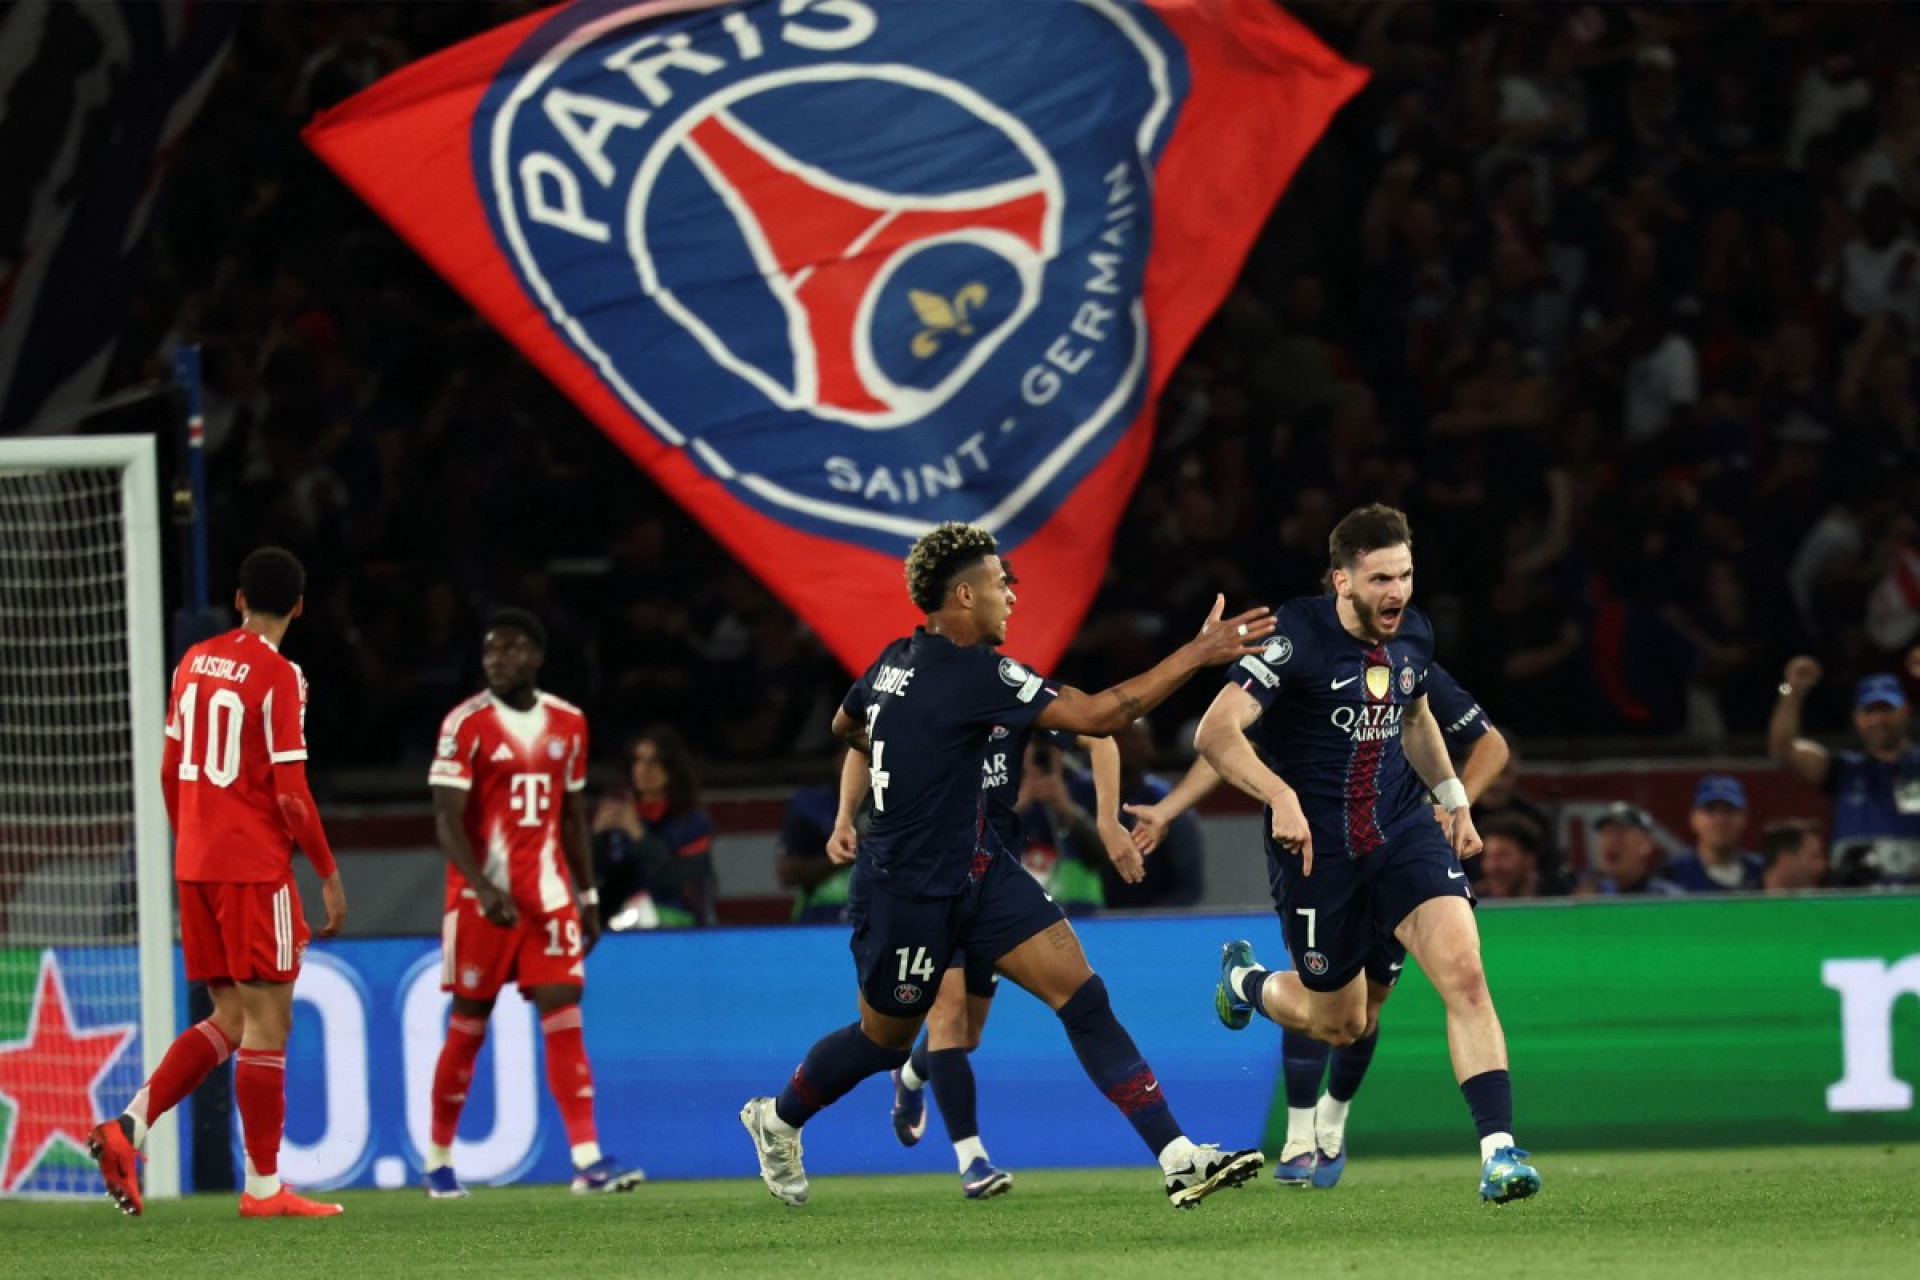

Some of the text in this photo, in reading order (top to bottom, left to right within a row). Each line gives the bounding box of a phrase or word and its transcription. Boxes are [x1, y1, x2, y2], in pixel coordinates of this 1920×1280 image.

[519, 0, 877, 243] PARIS
[190, 654, 250, 683] MUSIALA
[178, 682, 246, 789] 10
[509, 772, 552, 828] T
[543, 918, 582, 956] 19
[1295, 907, 1316, 948] 7
[895, 946, 935, 982] 14
[237, 957, 538, 1188] 0.0
